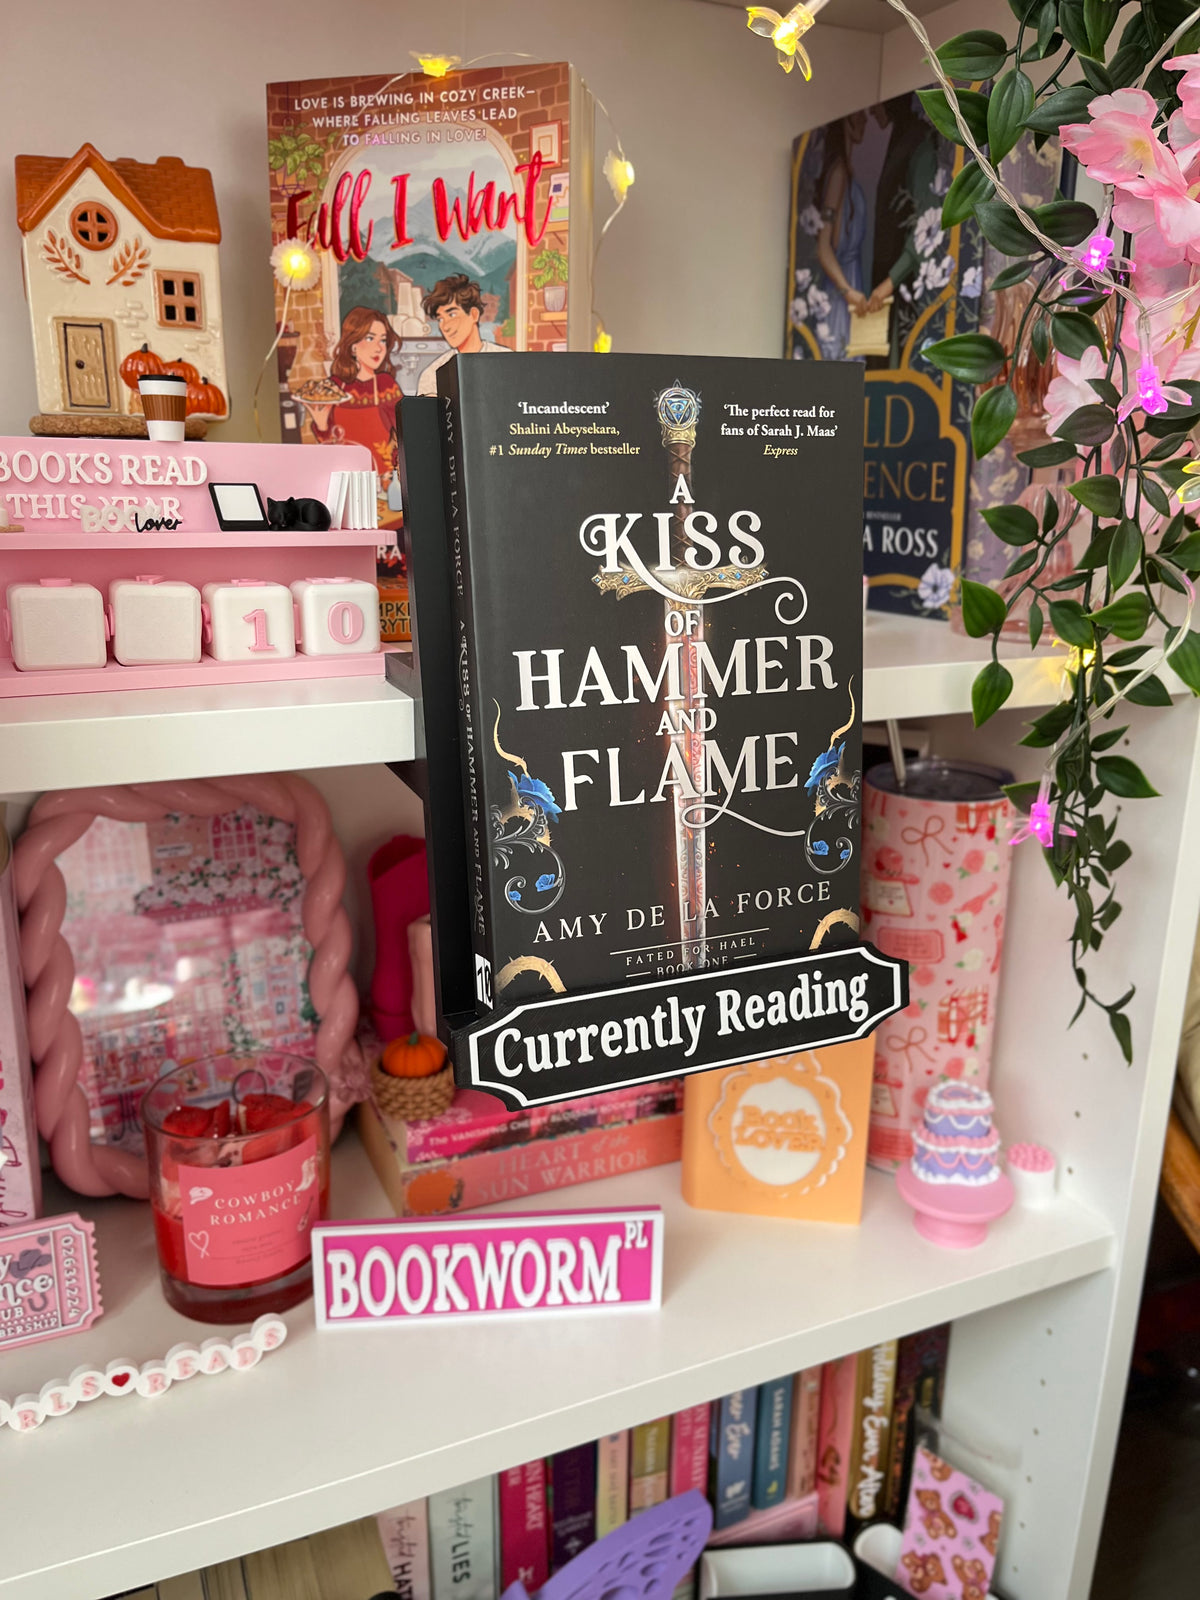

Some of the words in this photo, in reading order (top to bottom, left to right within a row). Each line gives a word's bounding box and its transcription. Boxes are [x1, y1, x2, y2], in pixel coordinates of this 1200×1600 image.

[295, 97, 328, 111] LOVE
[333, 96, 345, 109] IS
[350, 92, 414, 108] BREWING
[419, 91, 434, 105] IN
[440, 89, 477, 104] COZY
[312, 114, 360, 128] WHERE
[364, 112, 420, 126] FALLING
[426, 109, 477, 124] LEAVES
[482, 107, 518, 121] LEAD
[343, 134, 360, 147] TO
[365, 131, 421, 146] FALLING
[426, 131, 441, 144] IN
[447, 128, 487, 143] LOVE!
[286, 168, 374, 265] Fall
[390, 172, 415, 251] I
[431, 149, 556, 248] Want
[444, 396, 454, 444] AMY
[517, 401, 610, 416] ‘Incandescent’
[751, 404, 790, 422] perfect
[792, 405, 816, 419] read
[818, 405, 836, 419] for
[509, 422, 551, 437] Shalini
[553, 422, 621, 438] Abeysekara,
[720, 423, 745, 437] fans
[746, 423, 761, 437] of
[761, 423, 793, 437] Sarah
[794, 425, 804, 440] J.
[806, 424, 839, 438] Maas’
[489, 443, 504, 457] #1
[508, 443, 552, 459] Sunday
[555, 443, 588, 457] Times
[590, 443, 641, 457] bestseller
[763, 444, 799, 459] Express
[118, 453, 209, 487] READ
[449, 455, 457, 484] DE
[450, 490, 459, 518] LA
[669, 473, 696, 505] A
[6, 494, 87, 520] THIS
[579, 509, 772, 606] KISS
[881, 525, 939, 559] ROSS
[453, 526, 464, 597] FORCE
[664, 610, 701, 637] OF
[512, 634, 839, 711] HAMMER
[655, 707, 719, 737] AND
[561, 731, 803, 822] FLAME
[466, 718, 479, 822] HAMMER
[474, 862, 487, 937] FLAME
[533, 912, 608, 943] AMY
[626, 904, 666, 932] DE
[683, 897, 720, 923] LA
[736, 880, 832, 915] FORCE
[626, 950, 674, 967] FATED
[684, 945, 710, 957] FOR
[719, 937, 756, 952] HAEL
[656, 961, 695, 978] BOOK
[494, 996, 706, 1079] Currently
[714, 970, 870, 1038] Reading
[429, 1135, 449, 1148] The
[450, 1123, 509, 1143] VANISHING
[499, 1141, 585, 1176] HEART
[477, 1175, 531, 1202] SUN
[540, 1149, 649, 1187] WARRIOR
[210, 1192, 301, 1226] ROMANCE
[214, 1180, 295, 1210] COWBOY
[326, 1231, 622, 1318] BOOKWORM
[624, 1220, 648, 1249] PL
[147, 1326, 282, 1394] READS
[452, 1540, 471, 1584] LIES
